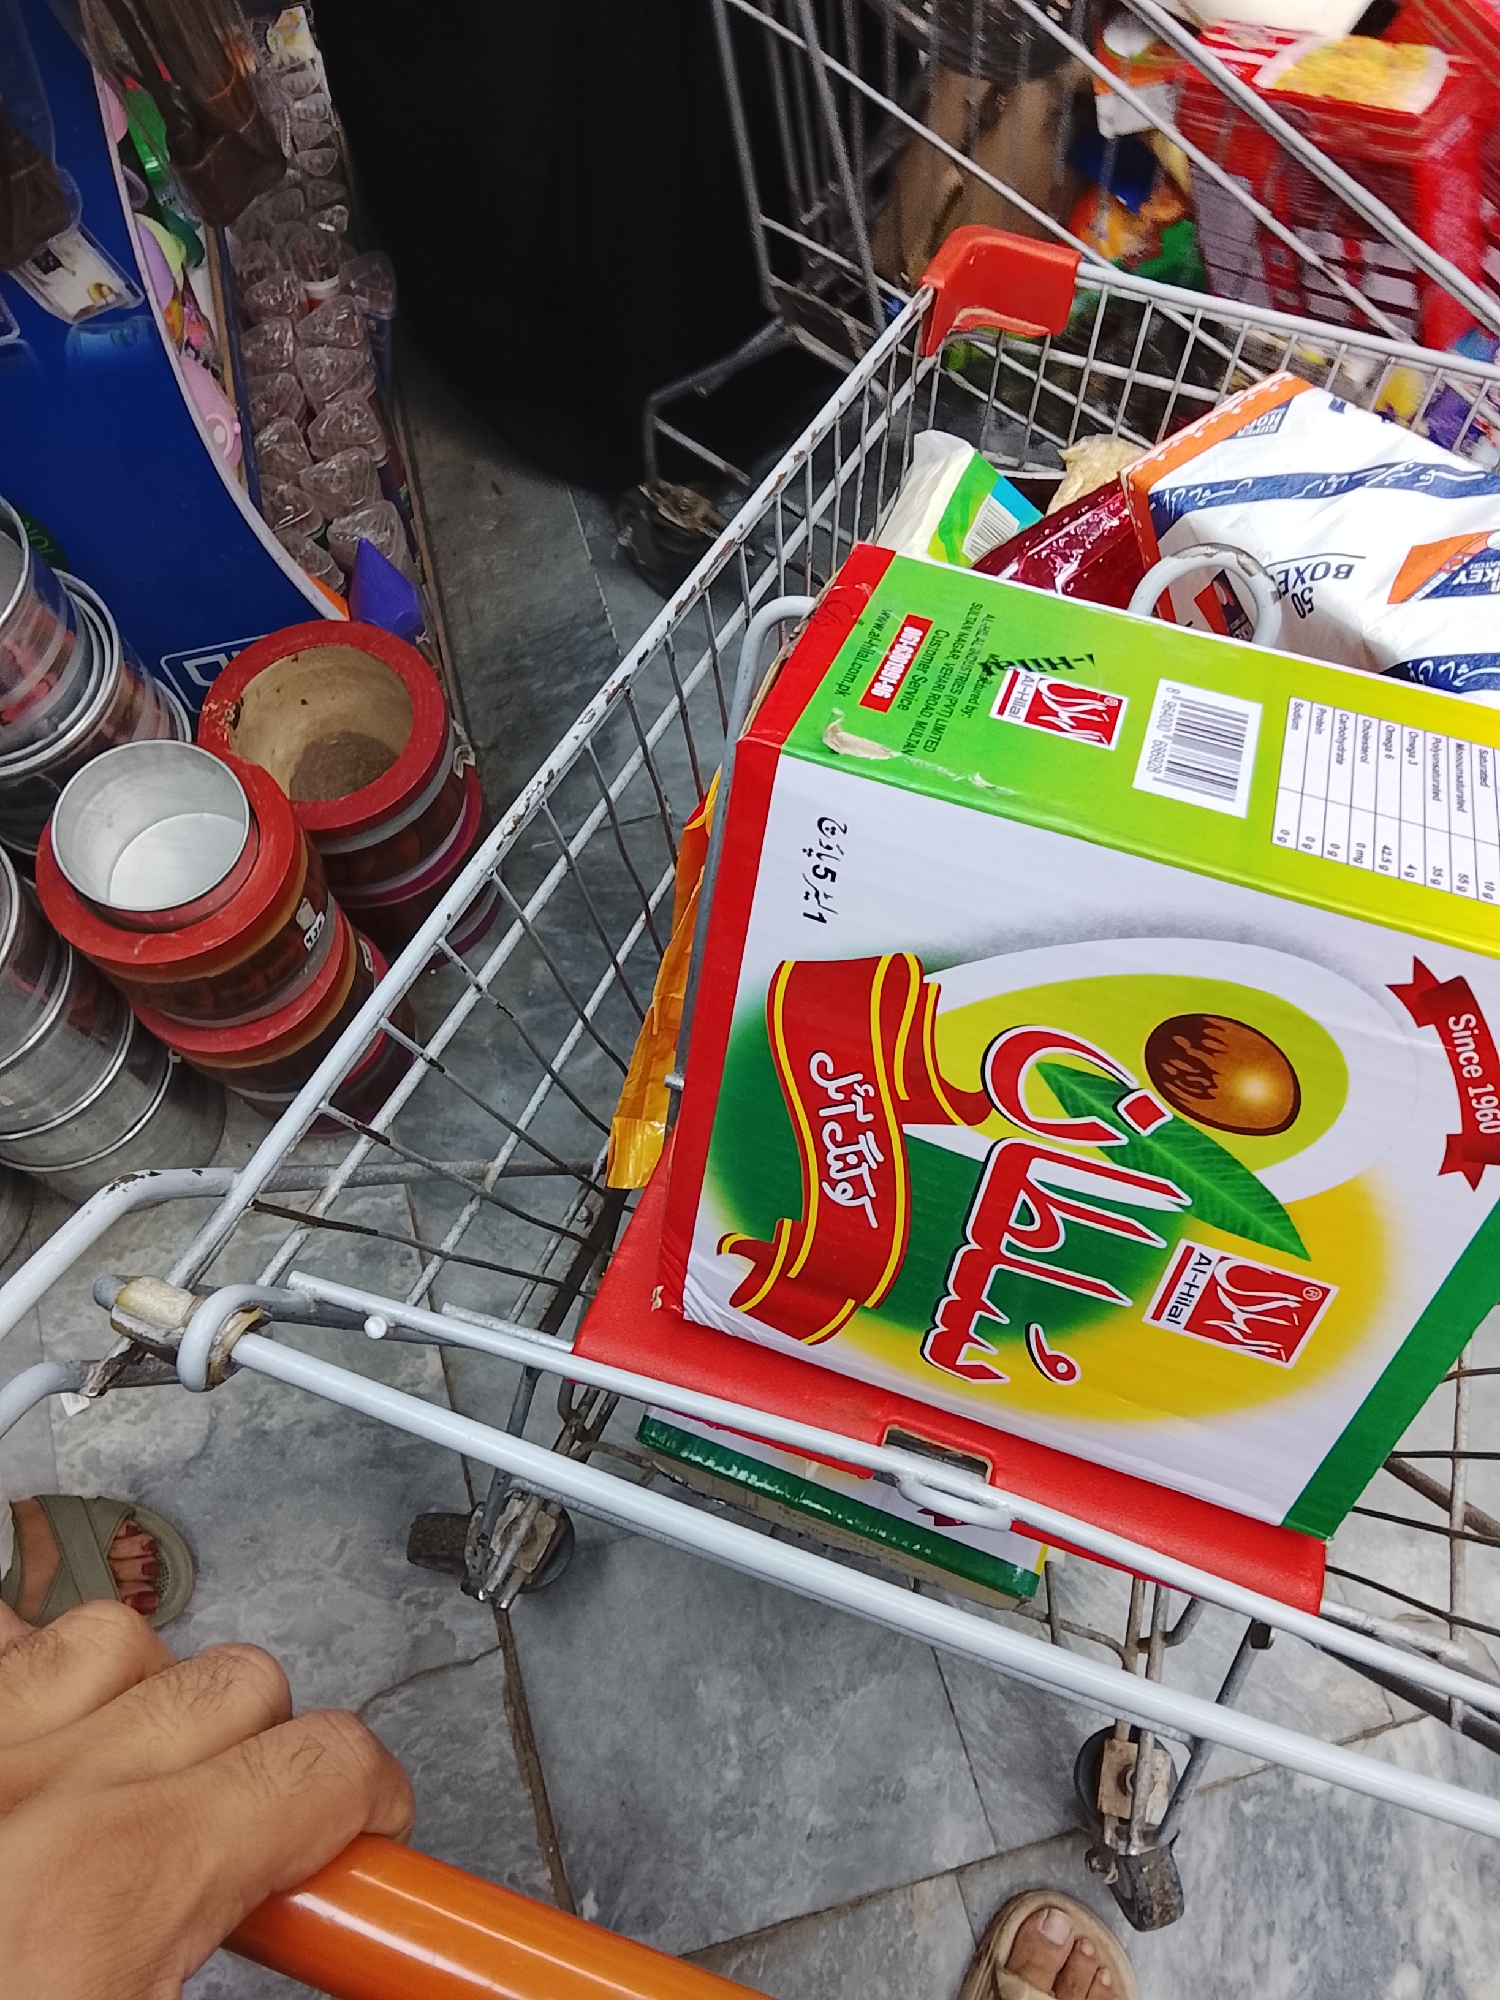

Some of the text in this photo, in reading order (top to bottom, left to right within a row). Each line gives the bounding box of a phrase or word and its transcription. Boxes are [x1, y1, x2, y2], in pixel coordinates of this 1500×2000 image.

[1272, 563, 1355, 600] BOXE
[1290, 586, 1315, 620] 50
[834, 609, 893, 698] www.al-hilal.com.pk
[896, 628, 950, 712] Customer Service
[949, 647, 981, 696] INDUSTRIES
[900, 601, 984, 757] SULTAN NAGAR, VEHARI ROAD, MULTAN
[1007, 672, 1041, 720] Al-Hilal
[936, 694, 958, 719] (PVT)
[960, 704, 978, 719] by:
[1289, 700, 1303, 731] Sodium
[1313, 707, 1326, 735] Protein
[922, 717, 949, 753] LIMITED
[1145, 687, 1180, 775] 8 964000 686928
[1332, 713, 1349, 765] Carbohydrate
[1383, 724, 1395, 752] Omega
[1406, 730, 1417, 758] Omega
[1383, 752, 1395, 760] 6
[1429, 736, 1441, 802] Polyunsaturated
[1478, 748, 1490, 788] Saturated
[1352, 718, 1372, 865] Cholesterol 0 mg
[1455, 742, 1467, 813] Monounsaturated
[1279, 828, 1289, 836] 0
[1305, 835, 1314, 843] 0
[1329, 841, 1339, 850] 0
[812, 864, 837, 883] 5
[1406, 863, 1416, 871] 4
[803, 911, 827, 924] 1
[1448, 1013, 1500, 1134] Since 1960
[821, 1123, 884, 1229] کوکنگ
[1166, 1251, 1213, 1325] Al-Hilal
